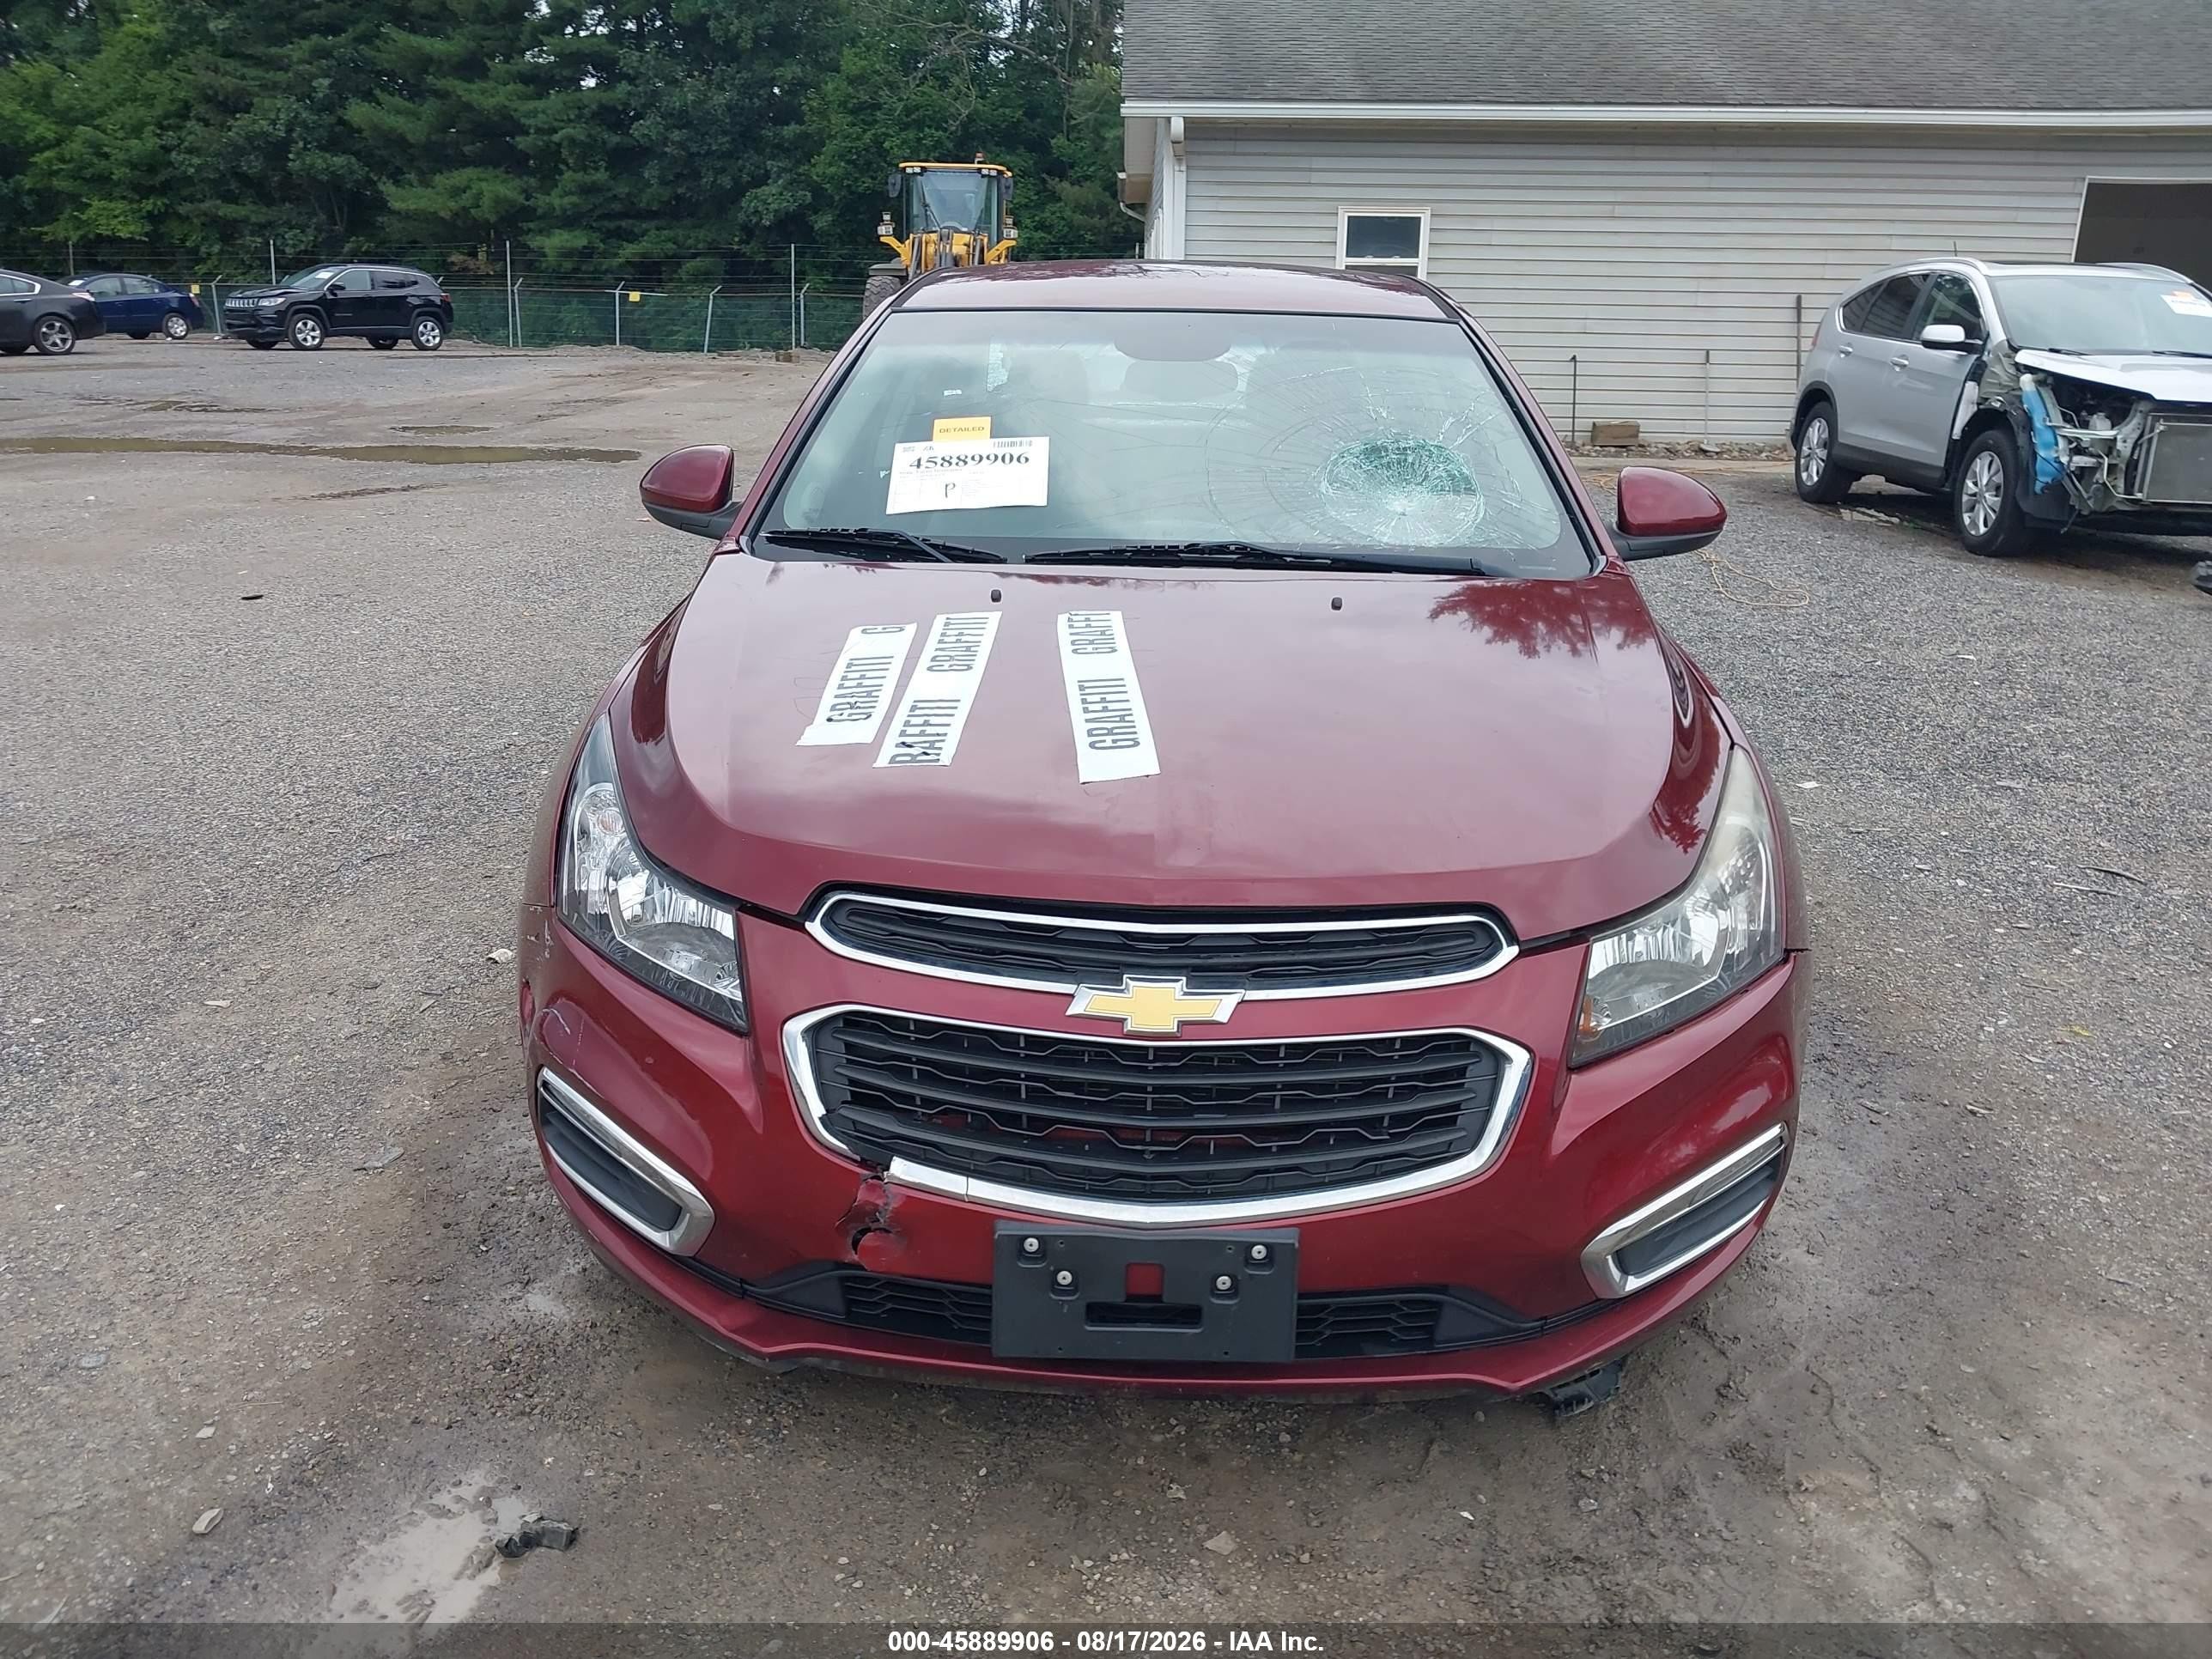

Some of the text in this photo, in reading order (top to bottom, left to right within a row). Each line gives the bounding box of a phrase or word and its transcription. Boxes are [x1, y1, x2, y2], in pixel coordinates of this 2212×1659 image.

[908, 452, 1030, 470] 45889906
[927, 617, 990, 672] GRAFFITI
[826, 655, 894, 723] GRAFFITI
[1077, 678, 1140, 750] GRAFFITI
